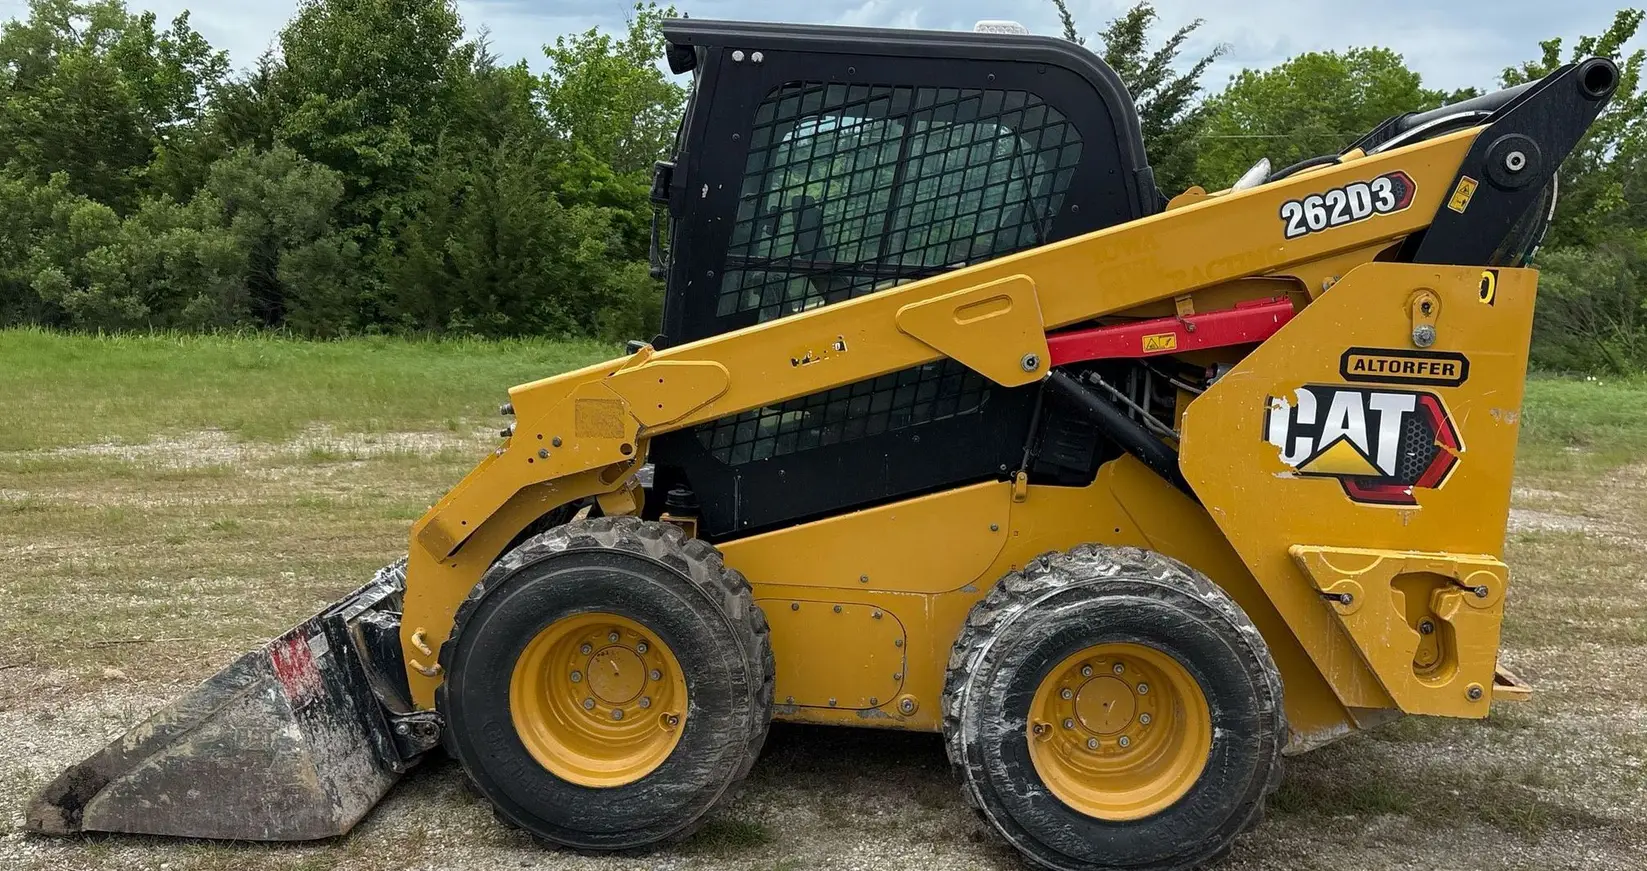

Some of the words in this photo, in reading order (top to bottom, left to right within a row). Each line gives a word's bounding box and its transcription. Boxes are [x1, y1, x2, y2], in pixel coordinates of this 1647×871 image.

[1281, 176, 1396, 237] 262D3
[1353, 358, 1456, 377] ALTORFER
[1268, 387, 1417, 477] CAT
